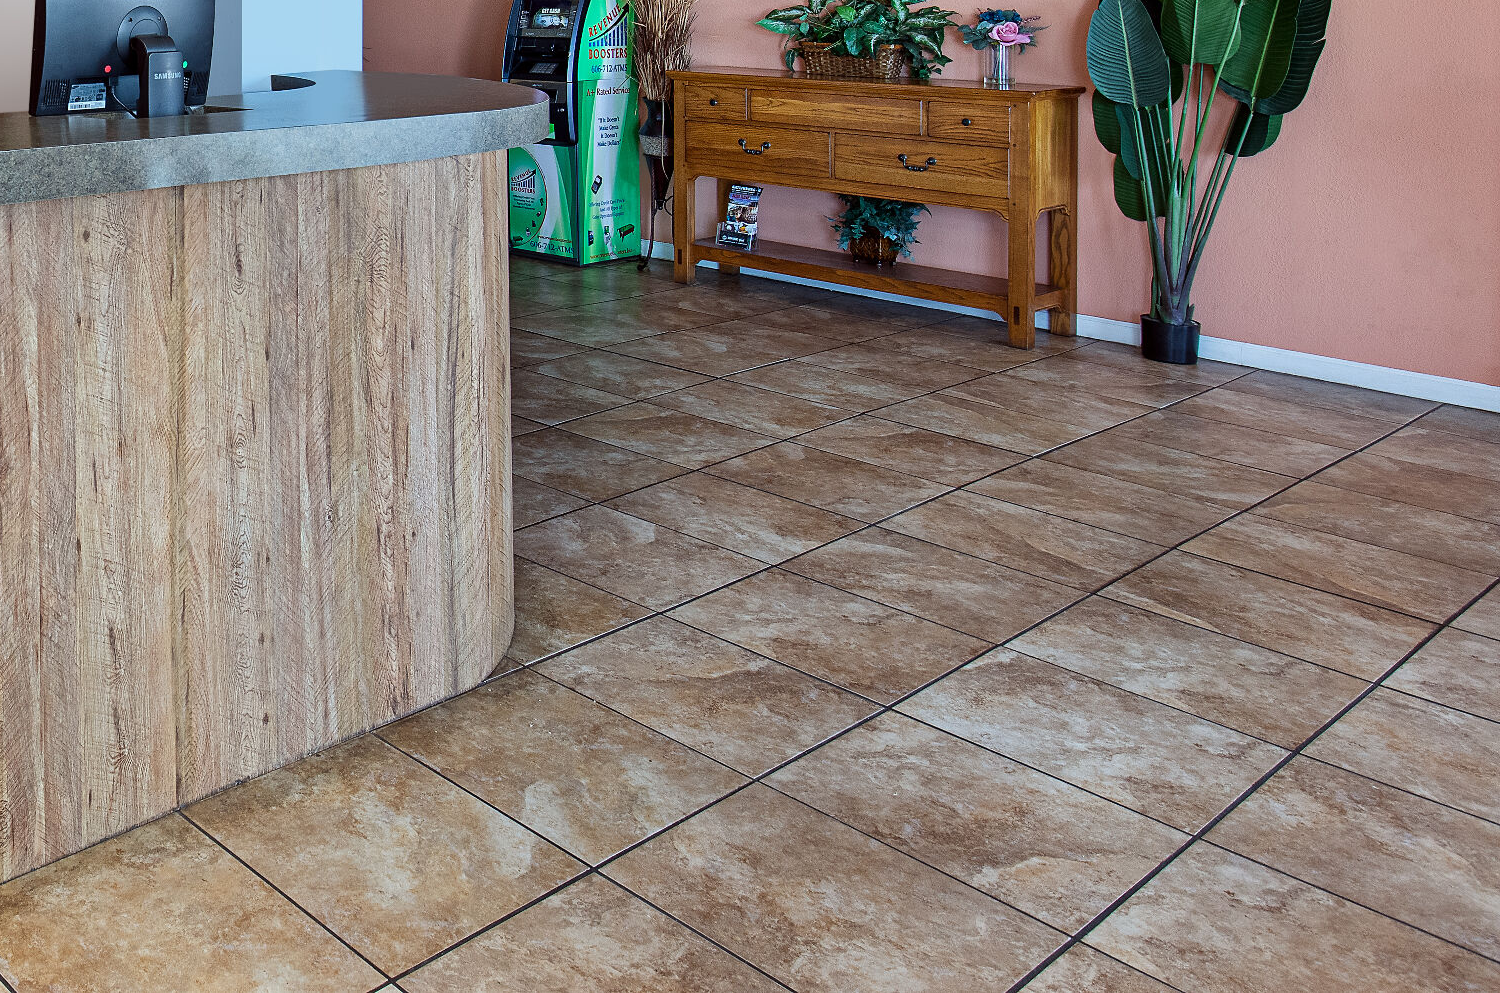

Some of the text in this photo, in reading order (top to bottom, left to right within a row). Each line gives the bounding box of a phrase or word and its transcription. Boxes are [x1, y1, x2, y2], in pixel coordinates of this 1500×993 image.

[588, 3, 622, 37] REVENUE
[588, 48, 628, 60] BOOSTERS
[590, 63, 628, 74] 606-712-ATMS
[154, 71, 182, 80] SAMSUNG
[586, 86, 630, 97] A+ Rated Service
